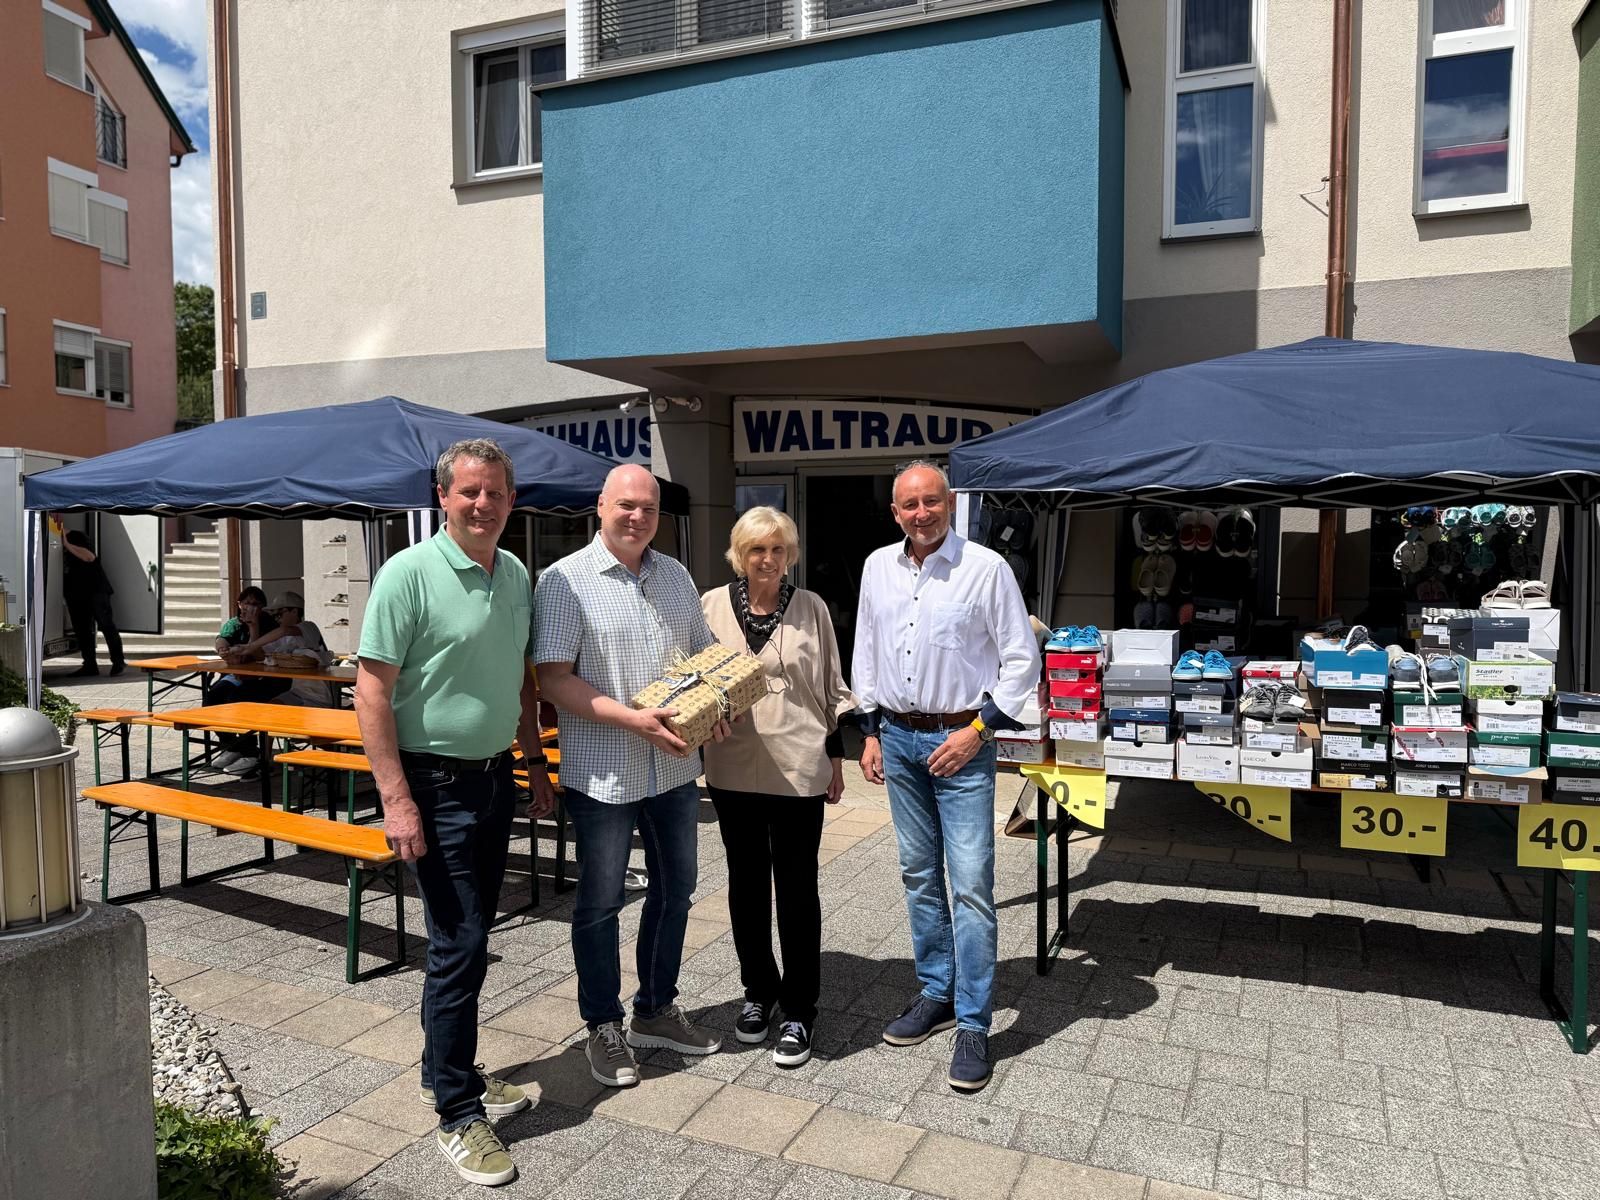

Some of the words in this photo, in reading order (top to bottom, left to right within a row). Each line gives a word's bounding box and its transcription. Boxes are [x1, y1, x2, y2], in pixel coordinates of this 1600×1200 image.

[536, 416, 651, 458] HAUS
[742, 409, 993, 454] WALTRAUD
[1352, 806, 1436, 838] 30.-
[1529, 818, 1600, 852] 40.
